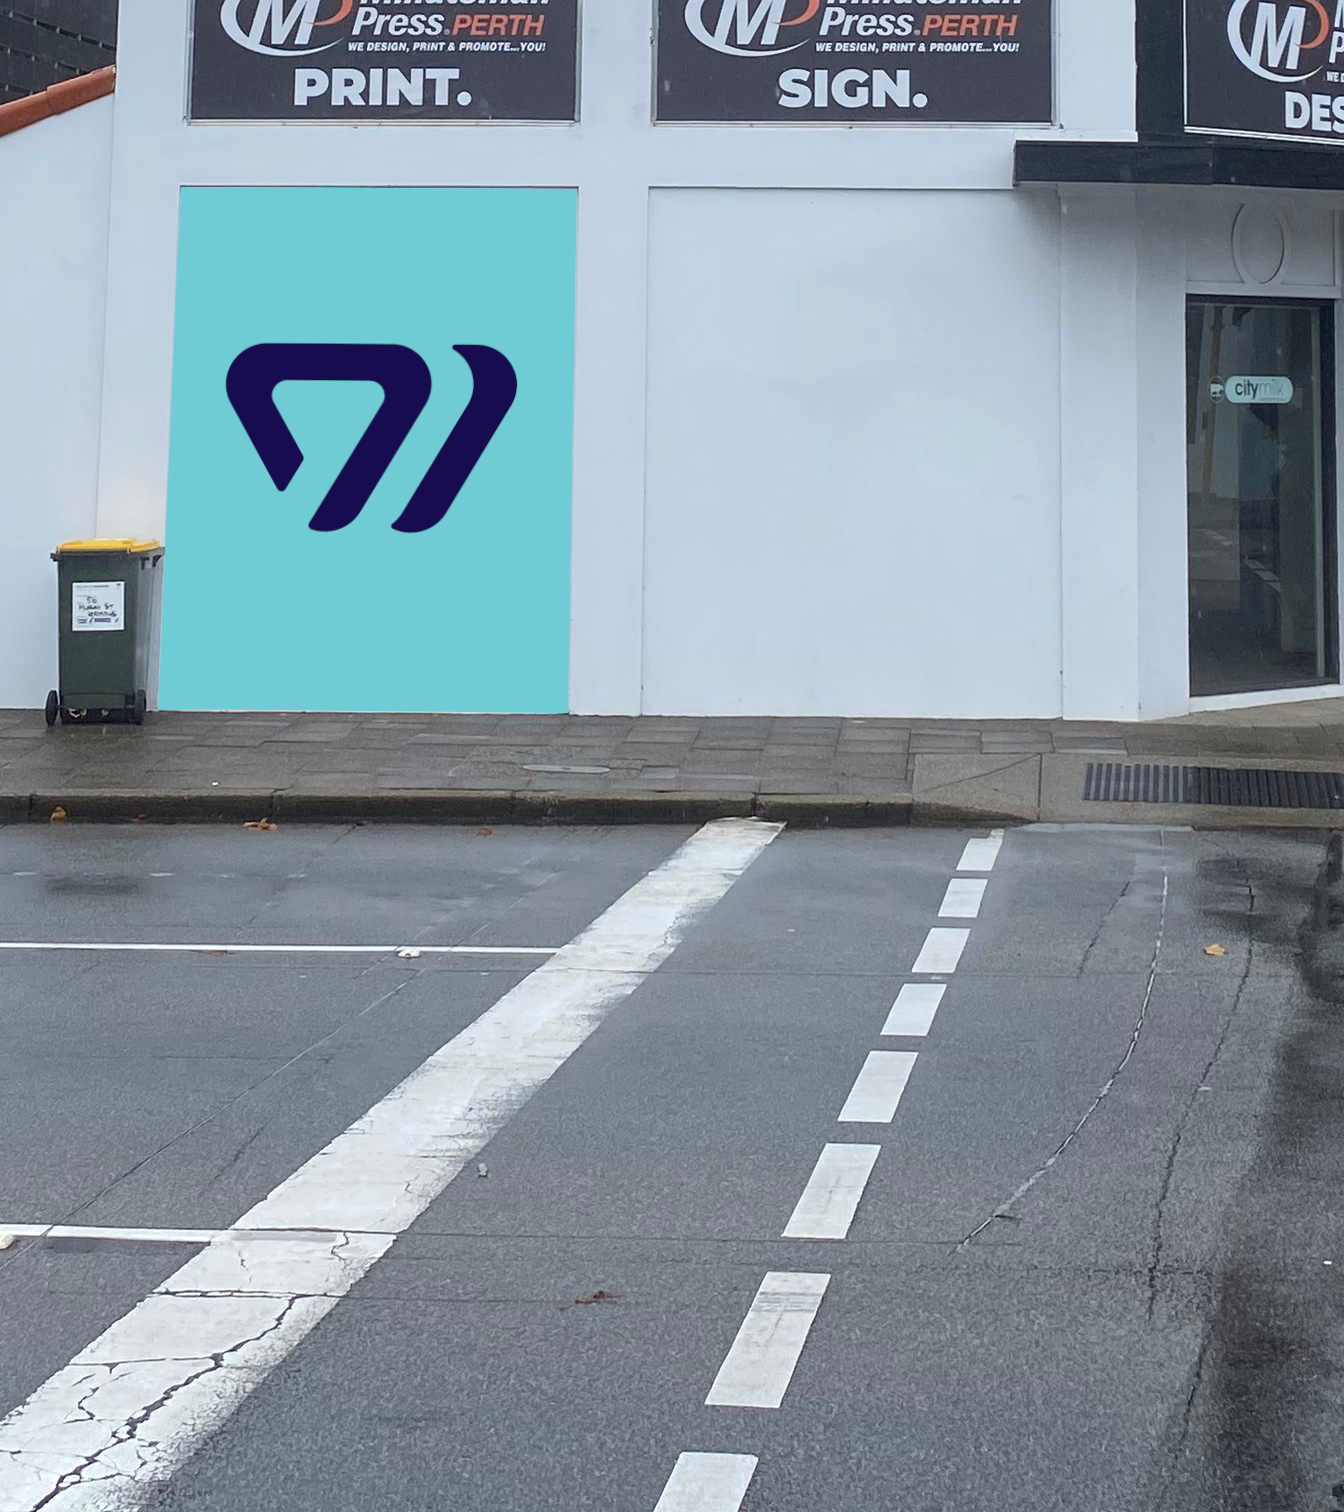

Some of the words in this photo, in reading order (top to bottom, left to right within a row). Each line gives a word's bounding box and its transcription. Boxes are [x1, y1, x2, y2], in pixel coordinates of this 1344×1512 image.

[452, 14, 545, 36] PERTH
[922, 14, 1019, 36] PERTH
[348, 42, 364, 52] WE
[366, 42, 410, 53] DESIGN,
[412, 42, 446, 52] PRINT
[447, 42, 456, 51] &
[815, 42, 833, 52] WE
[834, 42, 879, 54] DESIGN,
[882, 42, 917, 52] PRINT
[918, 42, 926, 52] &
[293, 67, 473, 106] PRINT.
[777, 68, 928, 108] SIGN.
[1326, 71, 1339, 83] WE
